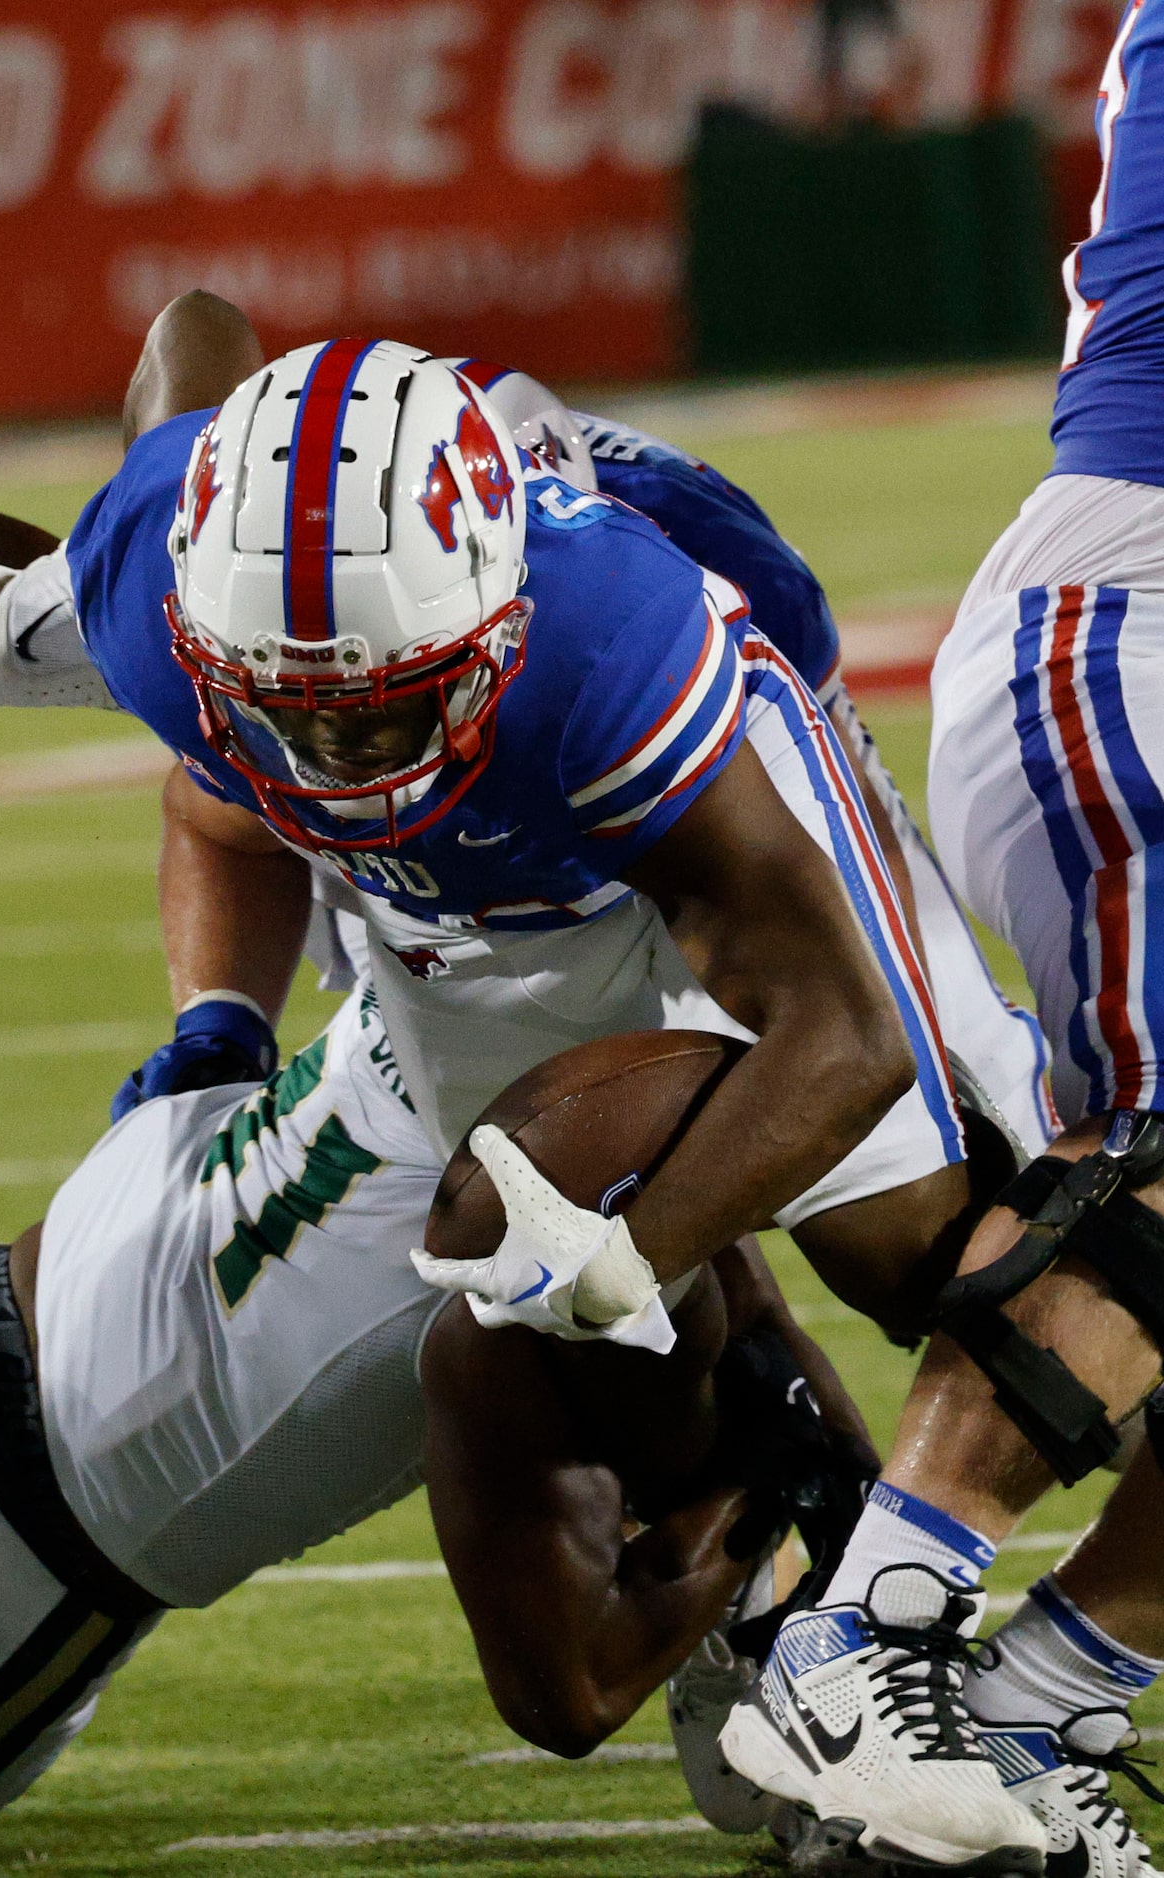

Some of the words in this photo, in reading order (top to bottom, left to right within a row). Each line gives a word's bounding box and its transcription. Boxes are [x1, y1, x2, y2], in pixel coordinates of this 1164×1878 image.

[79, 8, 481, 205] ZONE
[280, 644, 335, 664] SMU
[758, 1671, 792, 1737] FORCE
